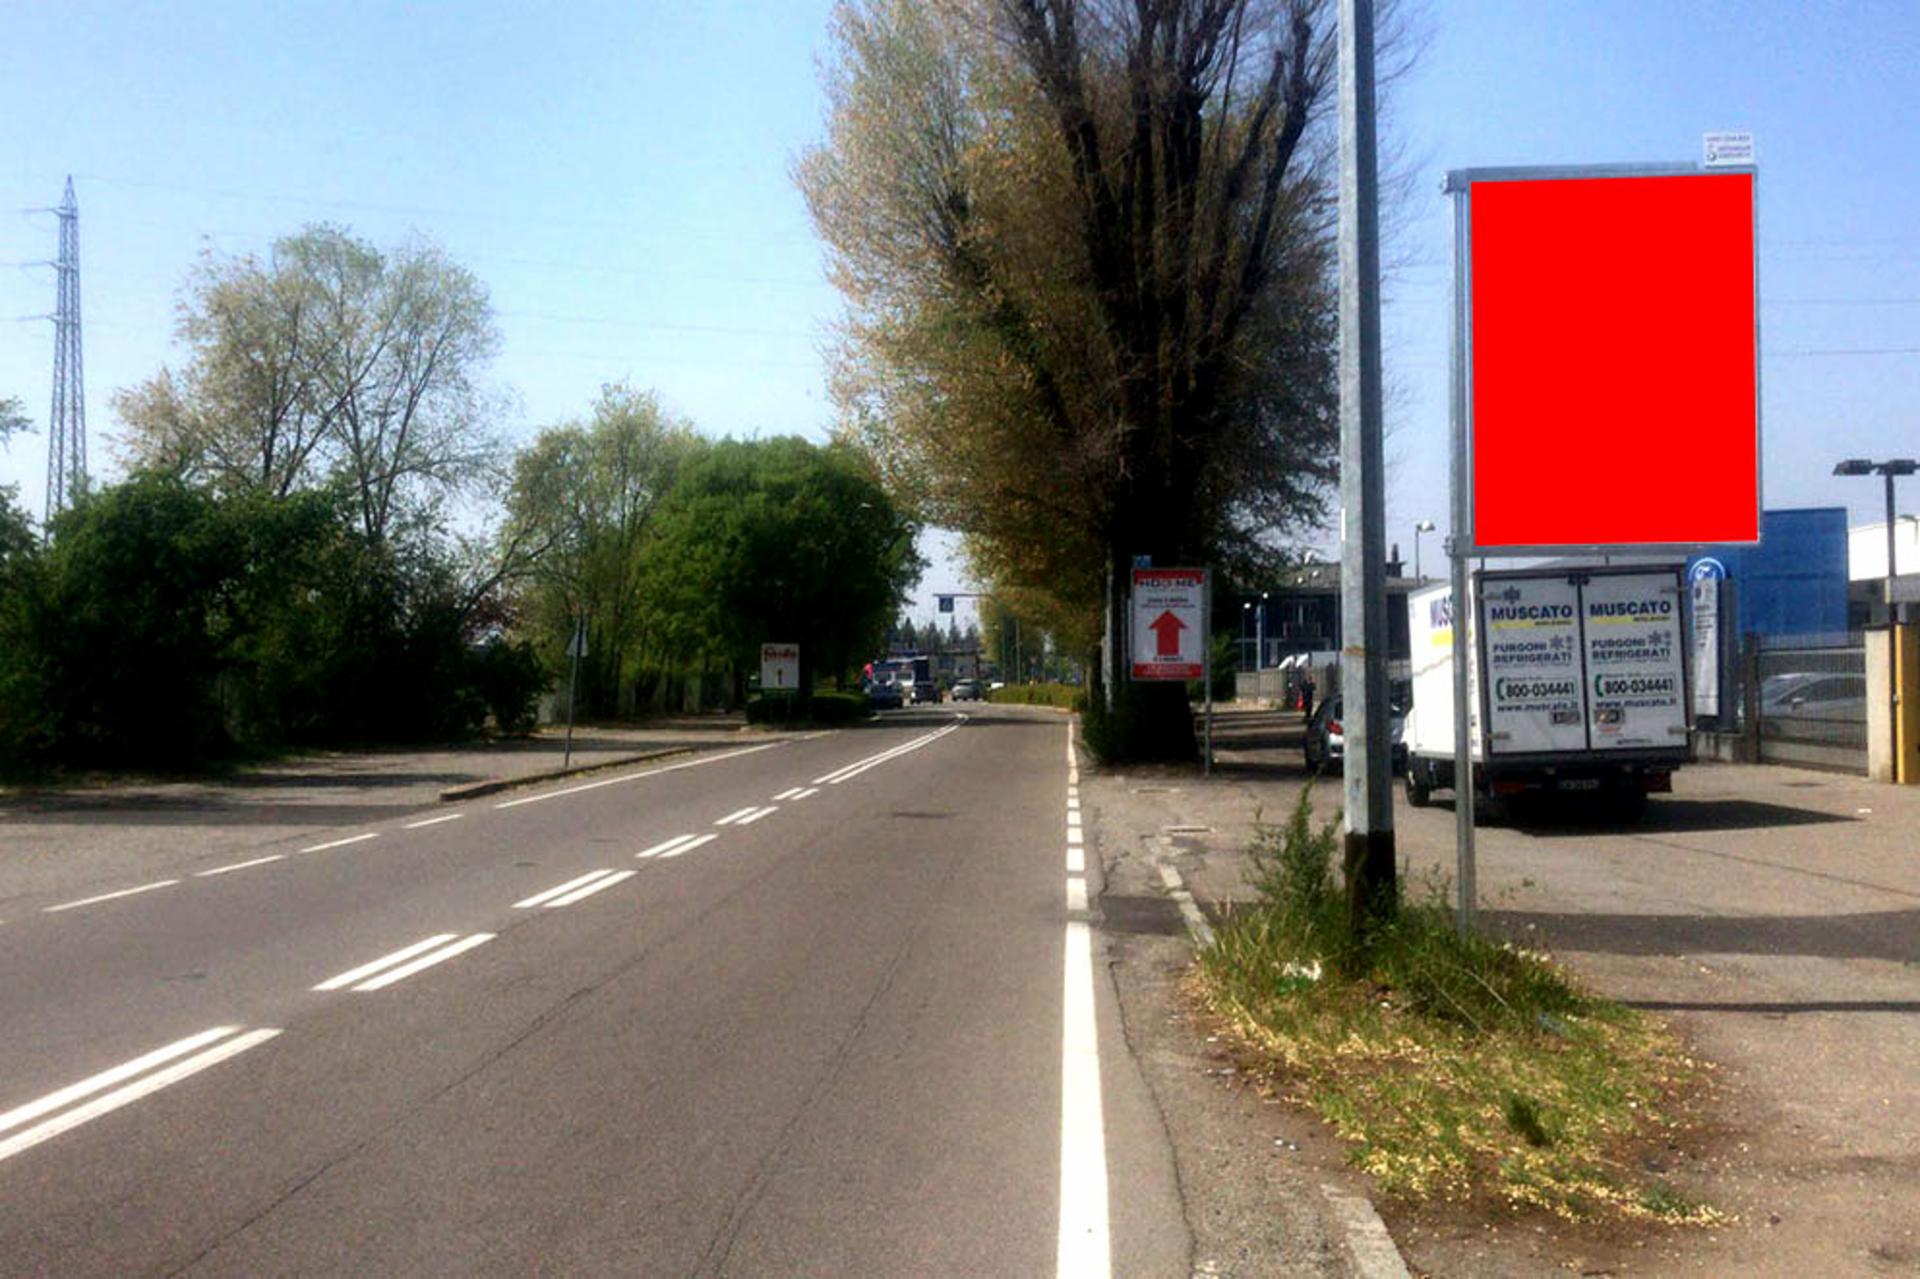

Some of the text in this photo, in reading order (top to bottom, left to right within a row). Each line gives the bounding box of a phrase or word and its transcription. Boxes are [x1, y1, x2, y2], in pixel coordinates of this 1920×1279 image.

[1491, 604, 1573, 620] MUSCATO
[1590, 600, 1671, 617] MUSCATO
[1493, 642, 1547, 653] FURGONI
[1591, 638, 1646, 649] FURGONI
[1493, 652, 1573, 663] REFRIGERATI
[1592, 648, 1671, 660] REFRIGERATI
[1506, 682, 1575, 698] 800-034441
[1604, 678, 1673, 695] 800-034441
